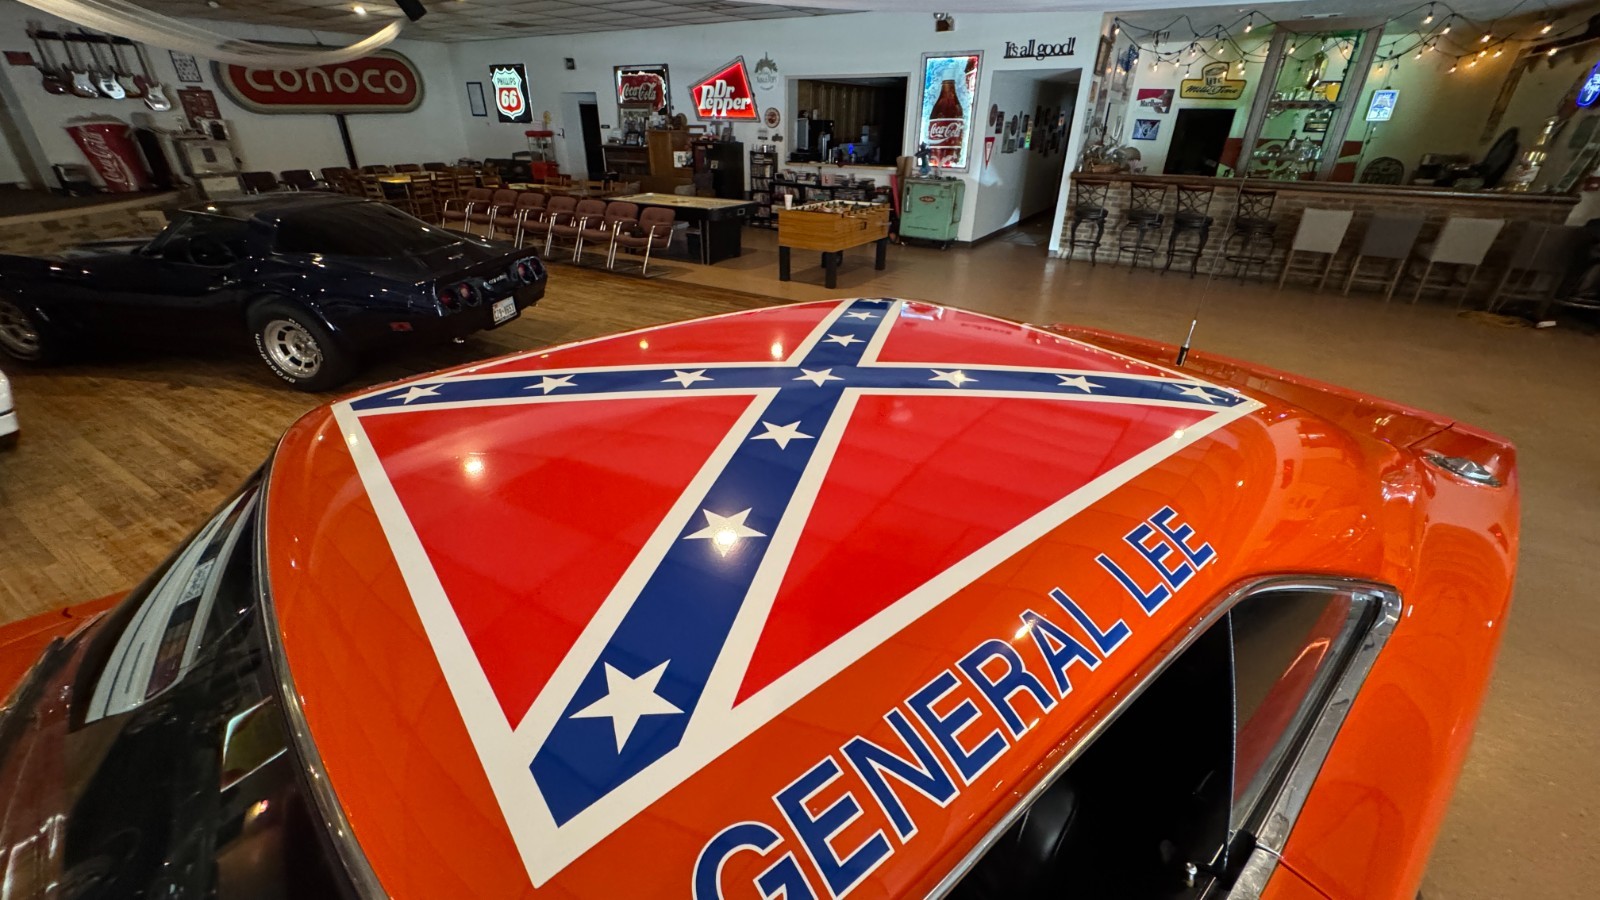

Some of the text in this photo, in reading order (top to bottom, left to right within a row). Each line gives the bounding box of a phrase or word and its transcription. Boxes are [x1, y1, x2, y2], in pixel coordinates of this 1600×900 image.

[1020, 38, 1036, 57] all
[1036, 36, 1076, 61] good!
[496, 77, 517, 86] PHILLIPS
[714, 79, 735, 98] Dr
[501, 89, 518, 107] 66
[622, 82, 657, 100] Coca-Cola
[698, 85, 751, 117] Pepper
[930, 122, 964, 138] Coca-Cola
[692, 505, 1218, 900] GENERAL LEE
